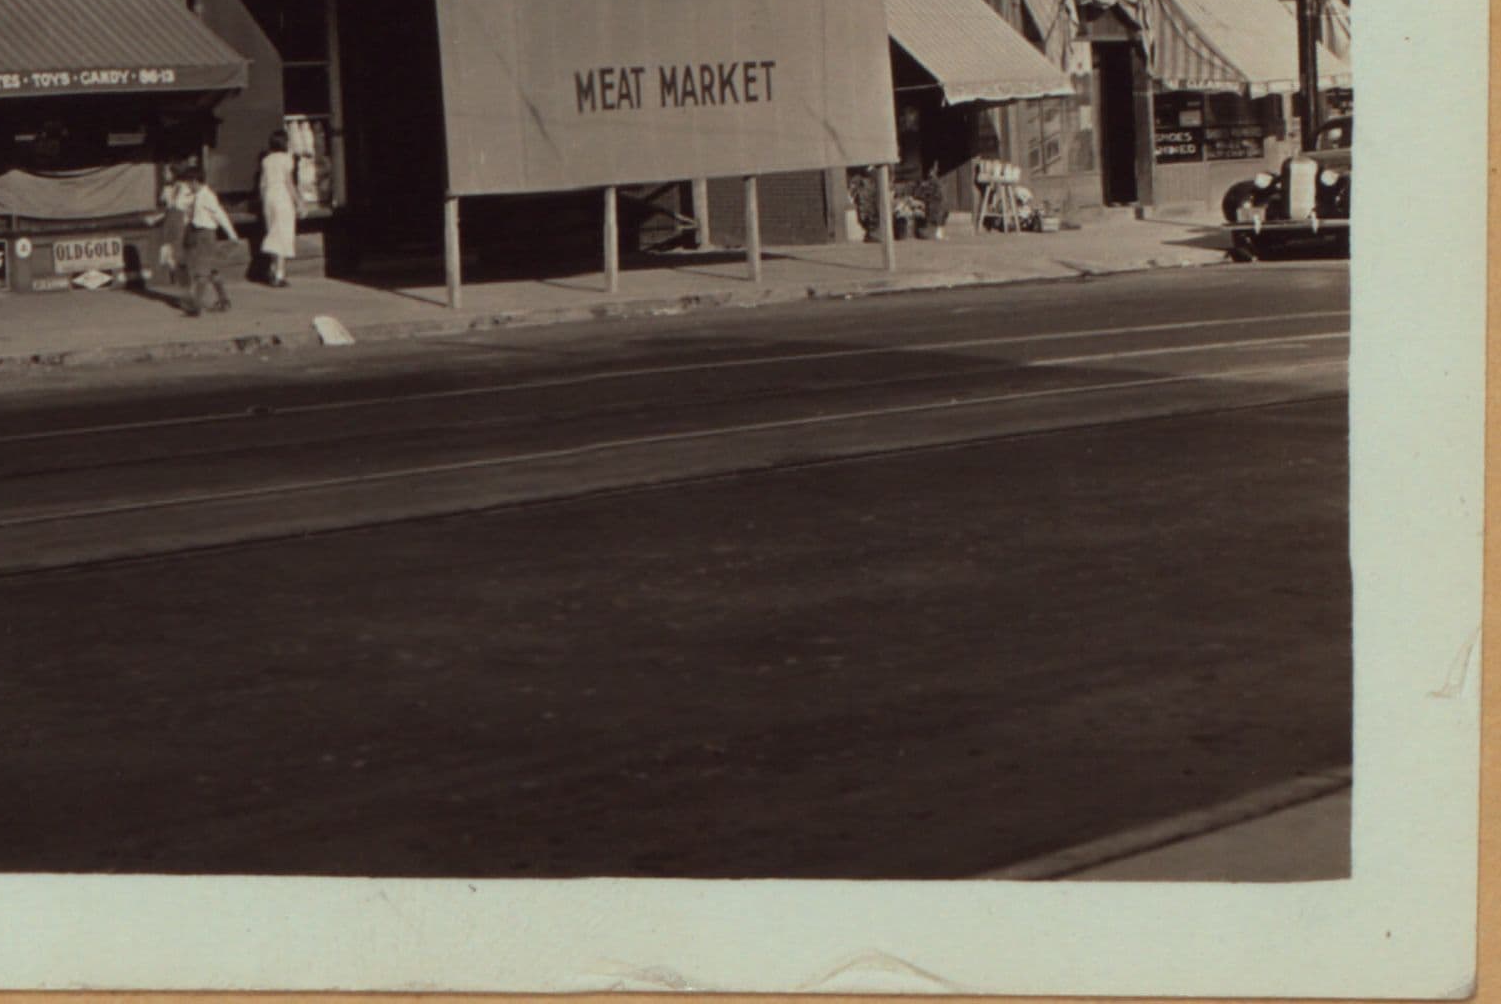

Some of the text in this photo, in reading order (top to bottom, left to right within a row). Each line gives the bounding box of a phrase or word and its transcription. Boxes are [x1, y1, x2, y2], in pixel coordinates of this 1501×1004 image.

[31, 71, 71, 88] TOYS
[80, 69, 131, 86] CANDY
[574, 60, 776, 114] MEAT MARKET
